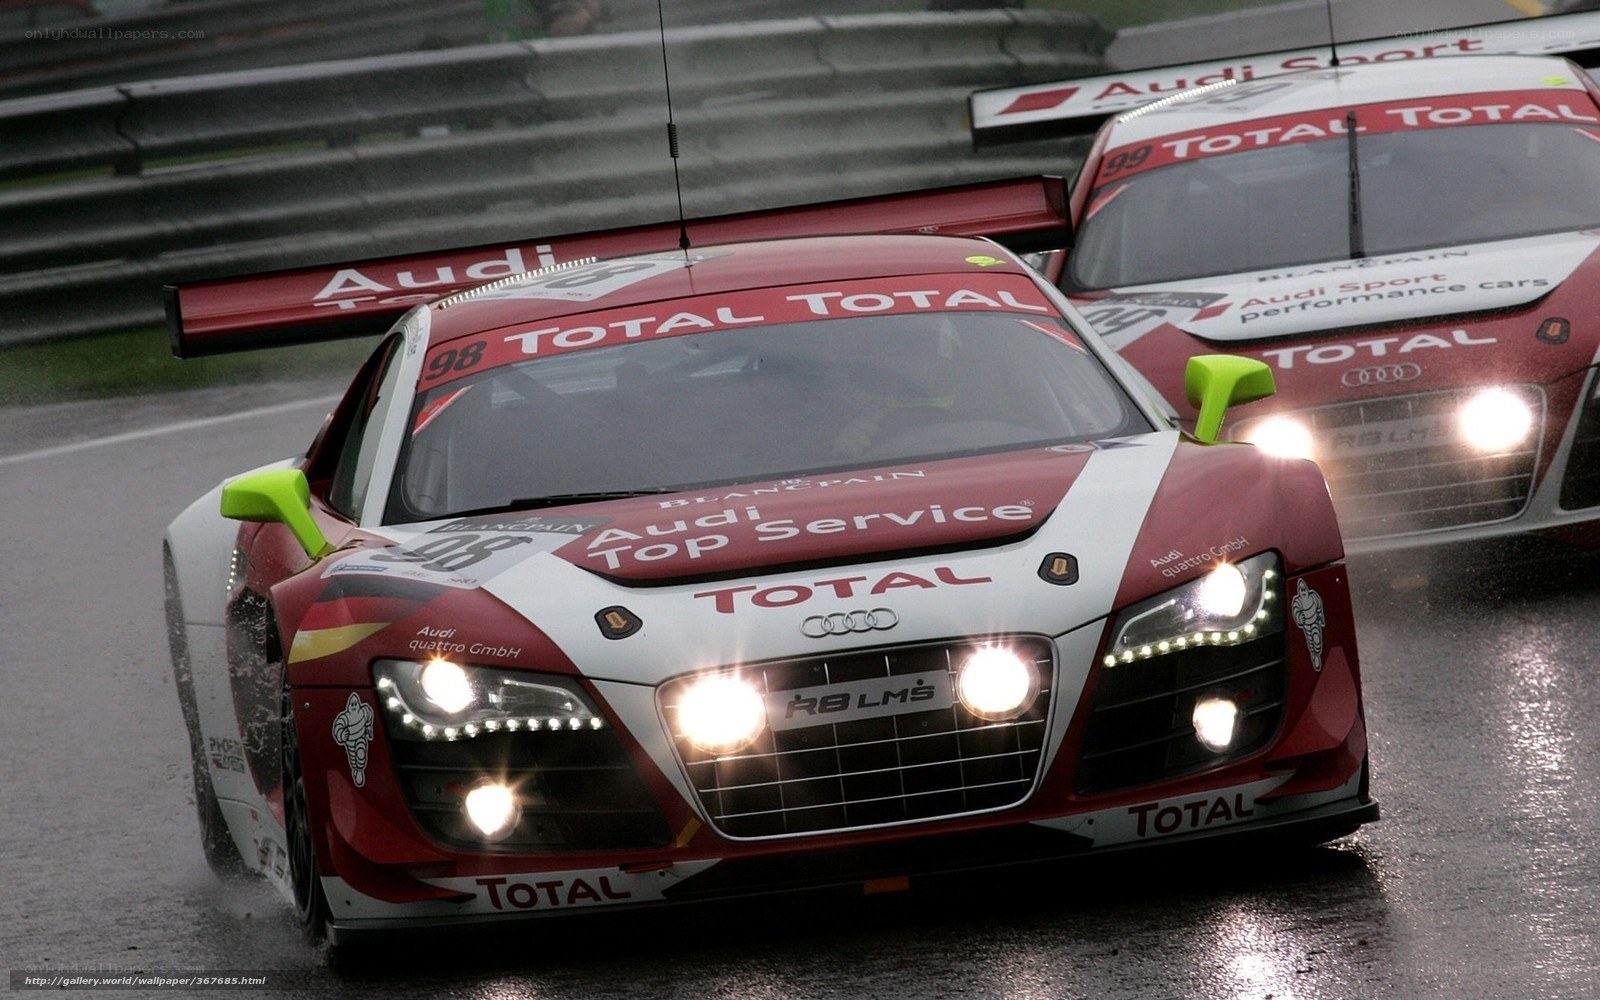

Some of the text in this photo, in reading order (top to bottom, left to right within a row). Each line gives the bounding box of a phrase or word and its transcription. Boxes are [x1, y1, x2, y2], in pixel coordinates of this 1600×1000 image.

[1093, 65, 1253, 100] Audi
[1102, 103, 1599, 178] 99 TOTAL TOTAL
[312, 244, 556, 300] Audi
[1239, 272, 1449, 310] Audi Sport
[1239, 276, 1550, 323] performance cars
[424, 340, 488, 381] 98
[503, 307, 765, 354] TOTAL
[785, 289, 1048, 315] TOTAL
[1262, 329, 1498, 369] TOTAL
[657, 469, 926, 509] BLANCPAIN
[447, 523, 596, 534] BLANCPAIN
[585, 506, 761, 550] Audi
[587, 532, 729, 571] Top
[1150, 549, 1185, 569] Audi
[1161, 536, 1250, 578] quattro GmbH
[693, 566, 993, 614] TOTAL
[408, 638, 522, 659] quattro GmbH
[416, 625, 457, 639] Audi
[784, 685, 935, 719] R8 LMS
[1127, 792, 1255, 838] TOTAL
[475, 876, 632, 910] TOTAL
